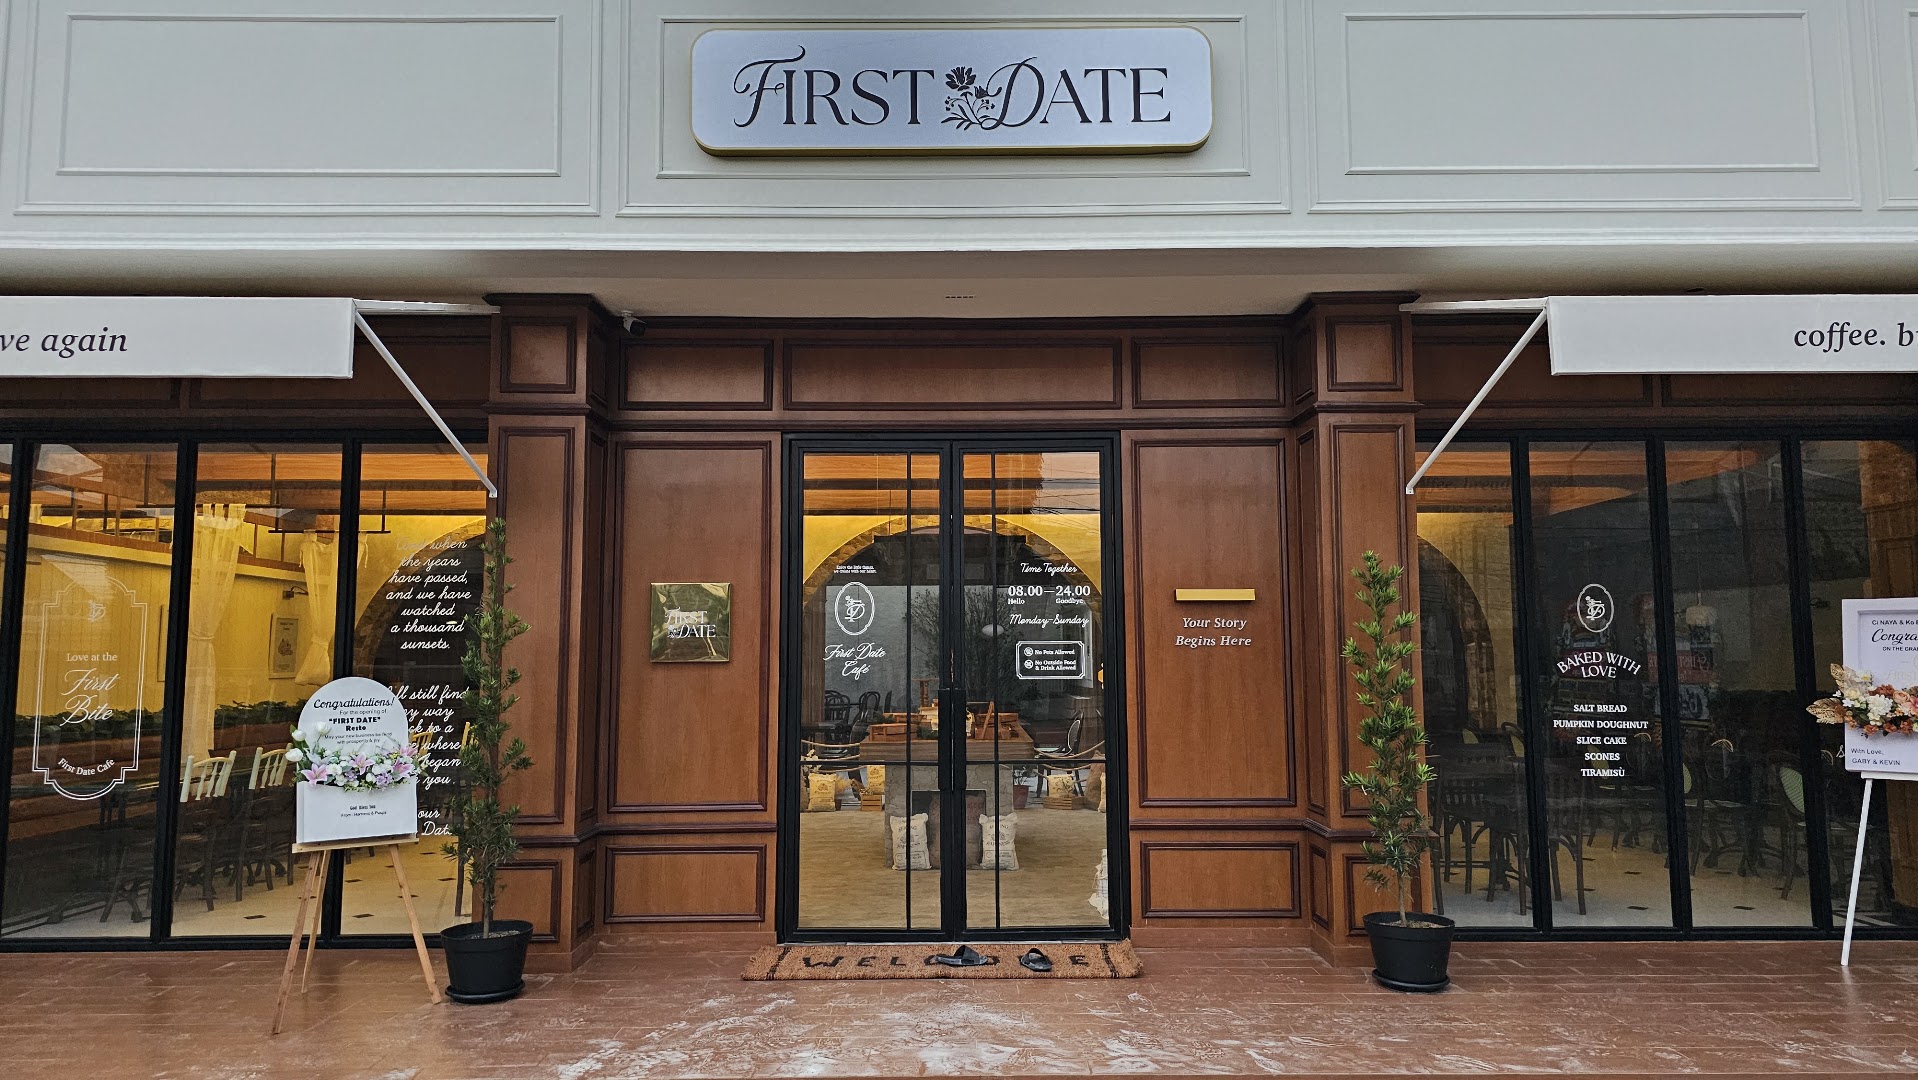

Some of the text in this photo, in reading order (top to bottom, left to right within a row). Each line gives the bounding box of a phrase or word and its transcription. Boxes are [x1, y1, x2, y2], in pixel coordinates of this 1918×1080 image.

[733, 45, 1171, 130] FIRST DATE
[41, 327, 127, 358] again
[1794, 321, 1886, 353] coffee.
[430, 536, 467, 549] when
[400, 554, 461, 571] the years
[1020, 562, 1077, 576] Time Together
[388, 570, 468, 587] have passed,
[386, 586, 472, 600] and we have
[1008, 585, 1042, 596] 08.00
[1055, 585, 1091, 596] 24.00
[401, 602, 455, 616] watched
[390, 619, 465, 633] a thousand
[1183, 617, 1247, 630] Your Story
[677, 624, 716, 639] DATE
[400, 638, 451, 650] sunsets.
[1175, 635, 1251, 648] Begins Here
[66, 652, 118, 662] Love at the
[823, 642, 886, 661] First Date
[1556, 651, 1603, 674] BAKED
[1606, 652, 1642, 675] WITH
[1581, 665, 1617, 679] LOVE
[61, 668, 120, 697] First
[388, 684, 410, 699] 'll
[409, 685, 440, 699] still
[60, 694, 115, 727] Bite
[313, 697, 395, 710] Congratulations!
[1573, 704, 1628, 713] SALT BREAD
[422, 709, 455, 722] way
[427, 722, 441, 733] to
[444, 725, 455, 733] a
[1553, 720, 1649, 729] PUMPKIN DOUGHNUT
[421, 736, 462, 749] where
[1576, 736, 1627, 745] SLICE CAKE
[1584, 753, 1621, 761] SCONES
[58, 758, 76, 773] First
[76, 766, 96, 776] Date
[422, 776, 456, 790] you.
[418, 809, 440, 818] our
[421, 820, 453, 836] Dat
